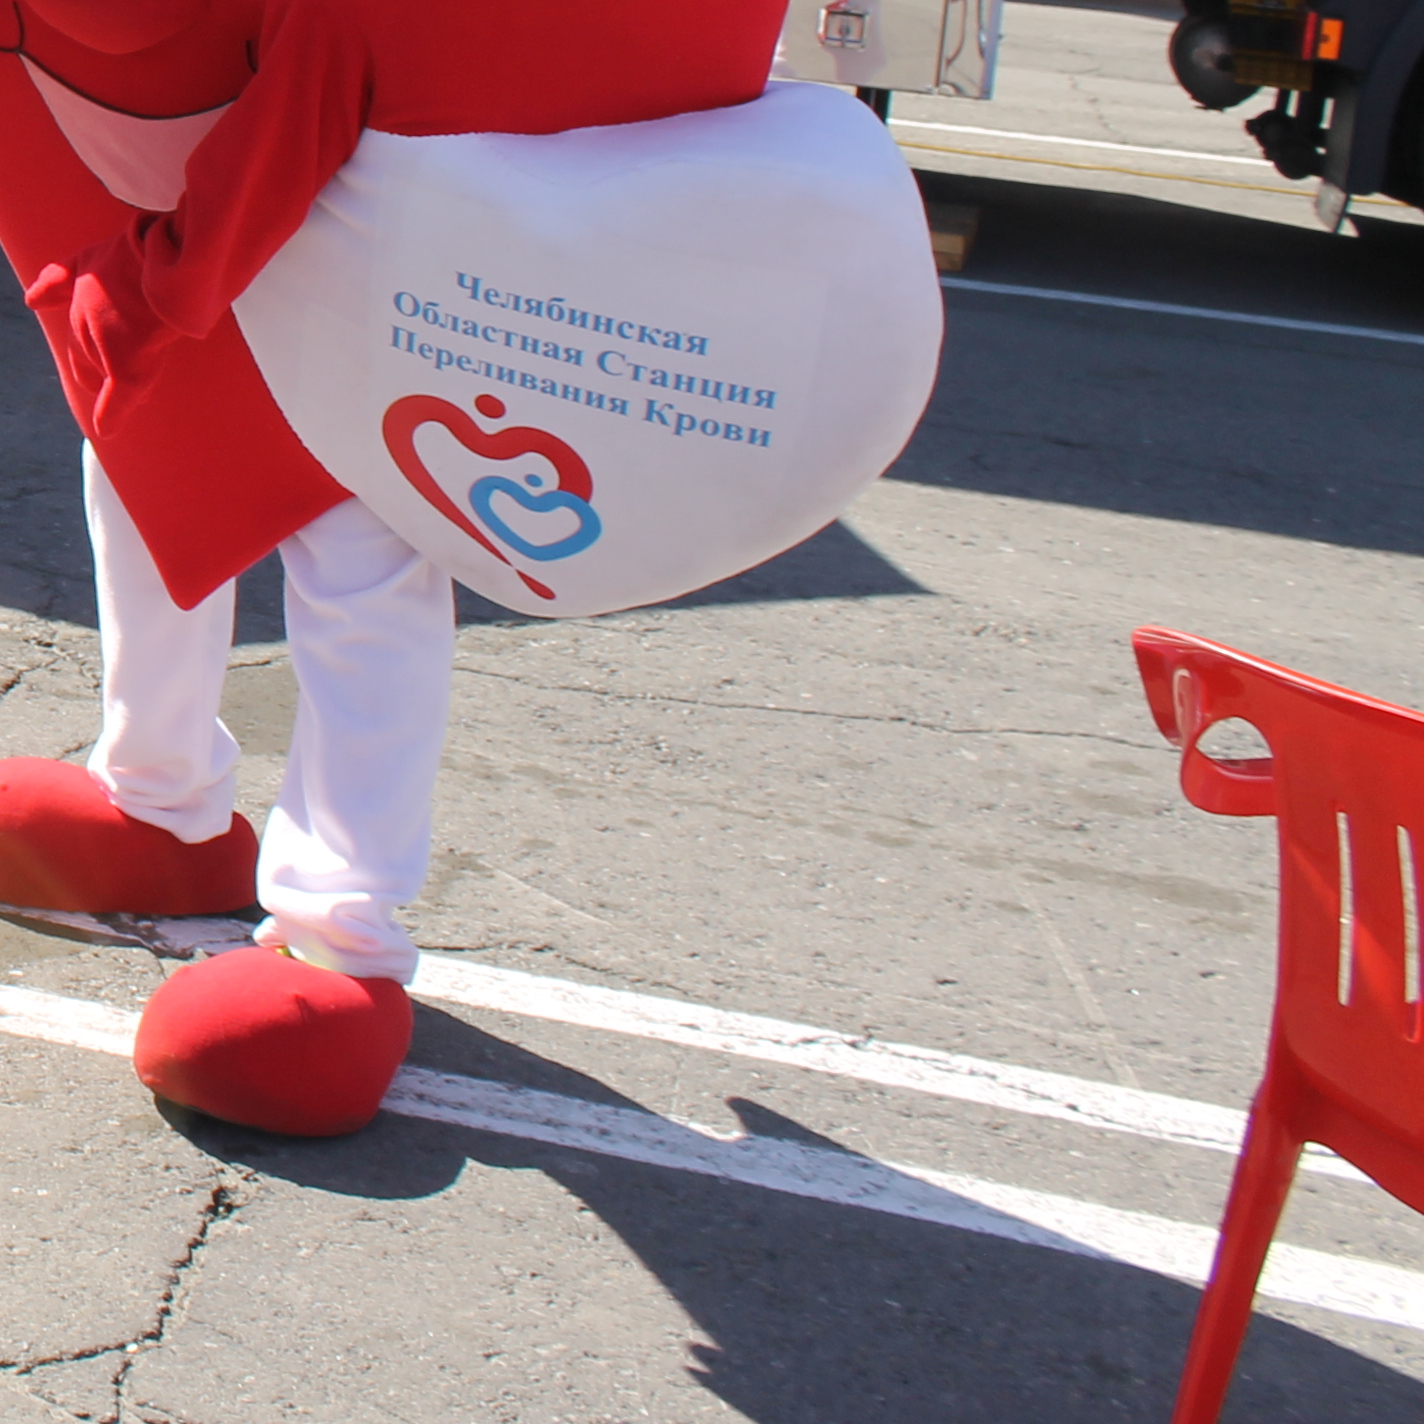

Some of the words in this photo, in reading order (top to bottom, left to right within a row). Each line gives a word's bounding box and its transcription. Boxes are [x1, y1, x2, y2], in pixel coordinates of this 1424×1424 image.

[393, 290, 585, 367] Областная
[596, 349, 777, 410] Станция
[455, 271, 710, 356] Челябинская
[389, 324, 630, 417] Переливания
[640, 397, 772, 448] Крови
